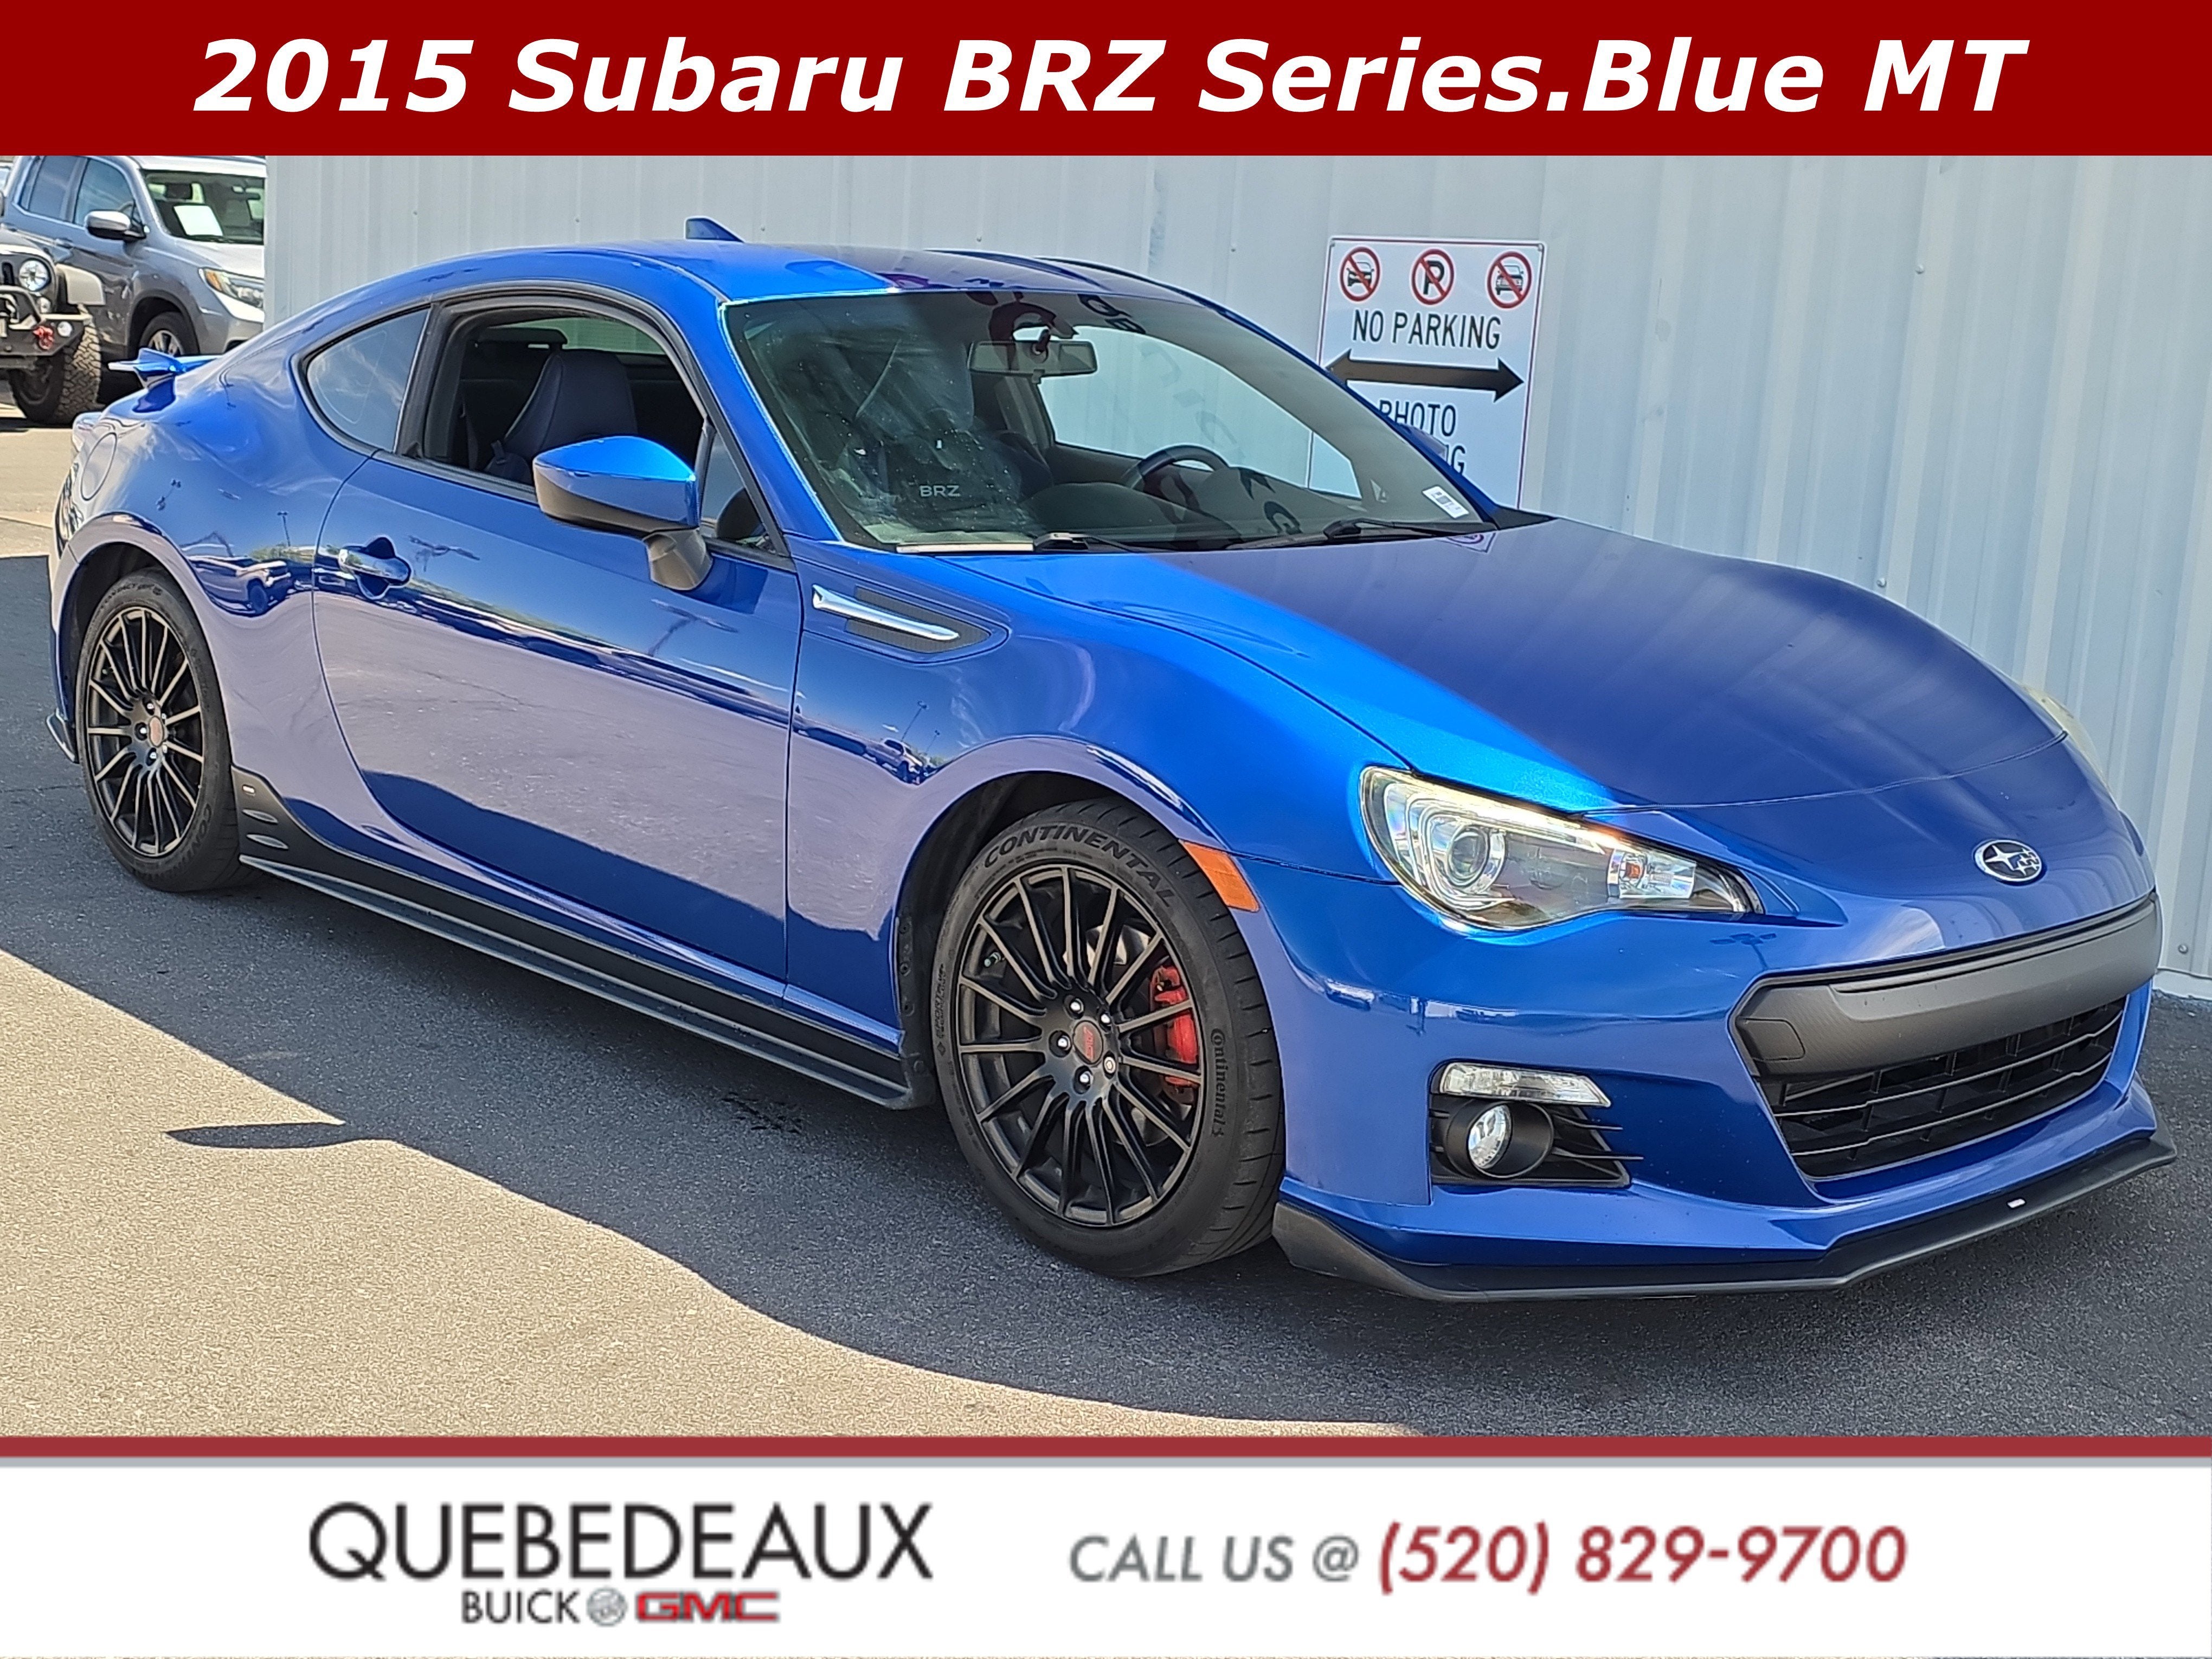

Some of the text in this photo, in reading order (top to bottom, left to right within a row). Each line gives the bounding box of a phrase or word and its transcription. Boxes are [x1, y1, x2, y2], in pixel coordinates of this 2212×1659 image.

[1353, 309, 1501, 350] NO PARKING
[1380, 400, 1456, 436] PHOTO
[919, 485, 961, 497] BRZ
[985, 825, 1175, 908] CONTINENTAL
